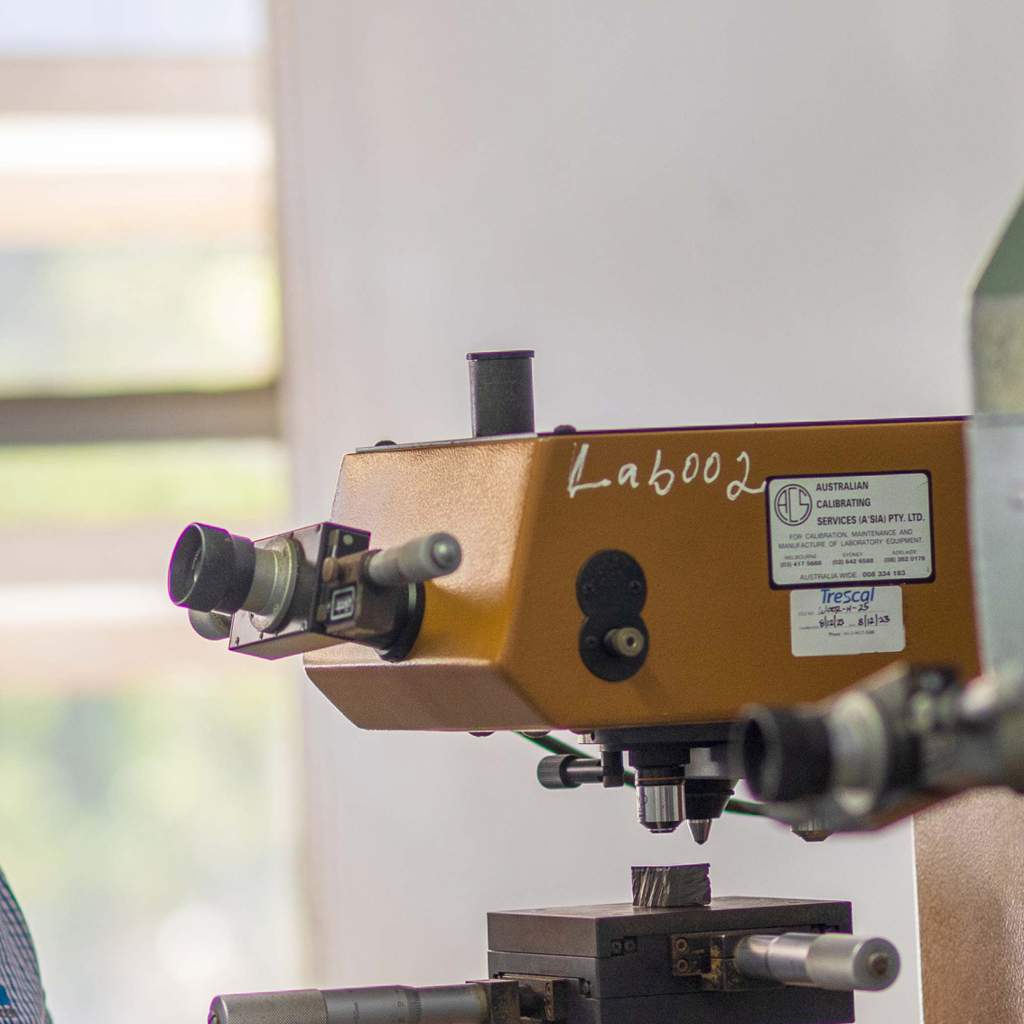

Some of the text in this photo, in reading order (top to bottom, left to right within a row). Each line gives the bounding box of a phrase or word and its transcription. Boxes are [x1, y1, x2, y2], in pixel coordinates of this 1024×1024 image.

[816, 481, 869, 492] AUSTRALIAN
[816, 498, 872, 509] CALIBRATING
[817, 512, 926, 526] SERVICES (A'SIA) PTY. LTD.
[851, 529, 897, 537] MAINTENANCE
[778, 541, 825, 549] MANUFACTURE
[841, 539, 882, 547] LABORATORY
[820, 587, 875, 604] Trescal
